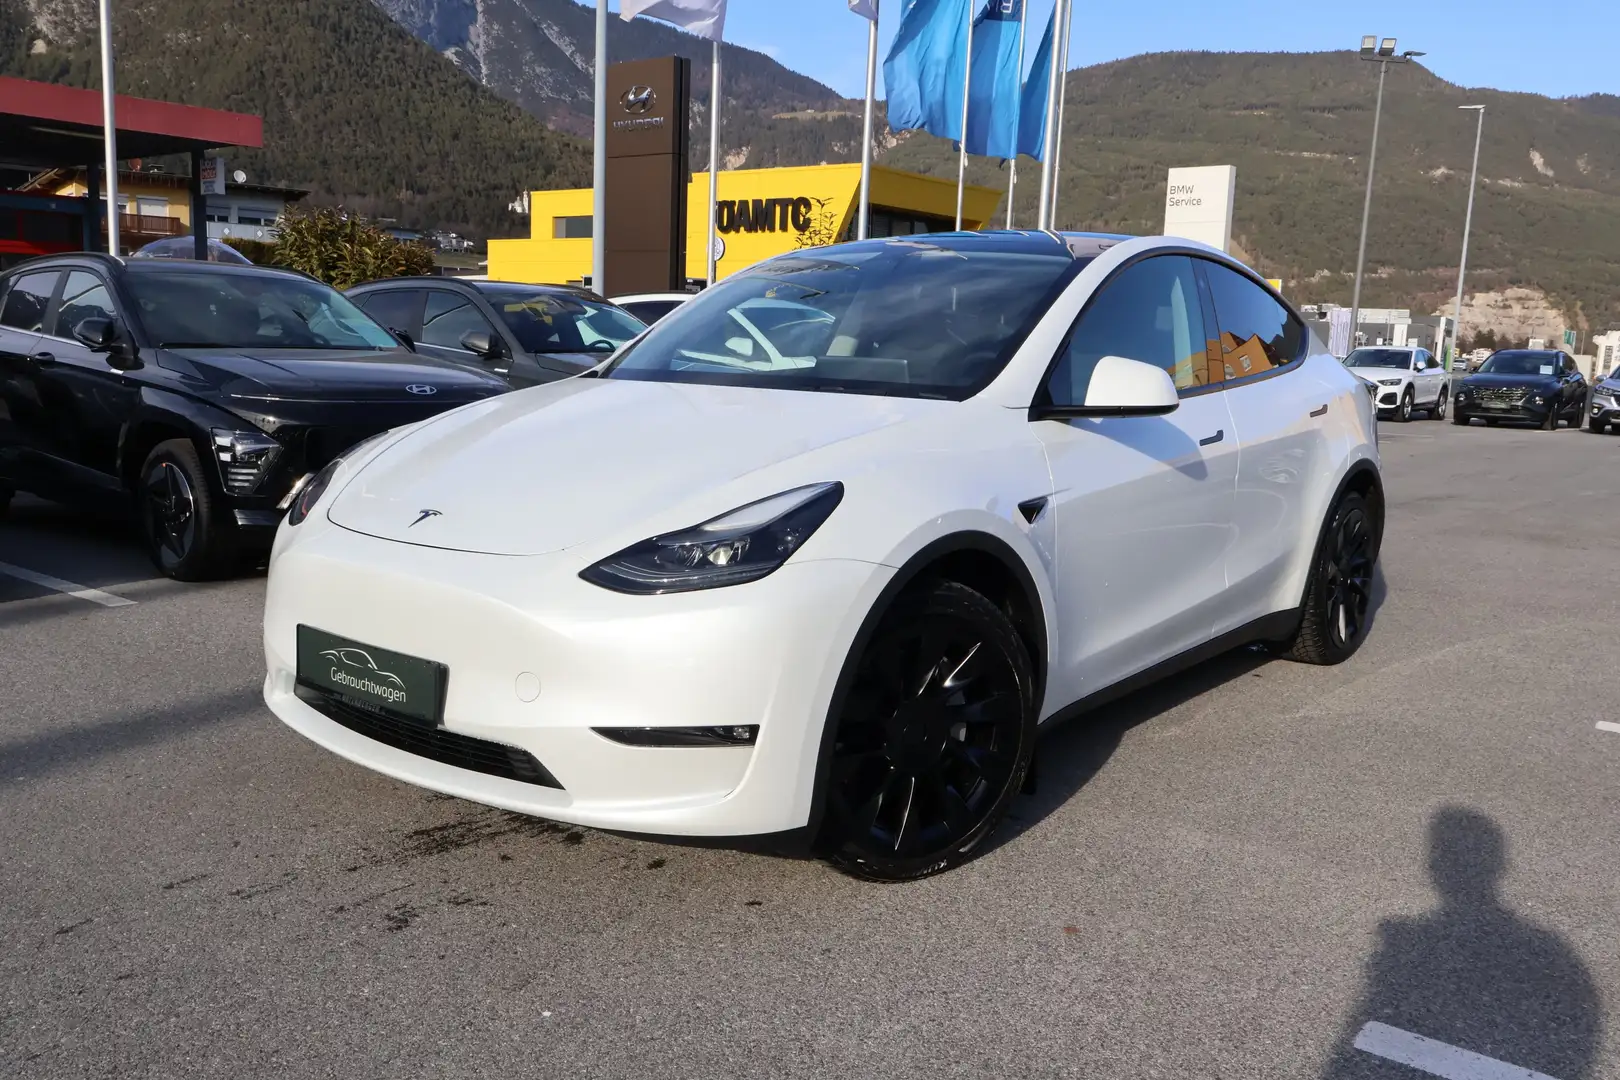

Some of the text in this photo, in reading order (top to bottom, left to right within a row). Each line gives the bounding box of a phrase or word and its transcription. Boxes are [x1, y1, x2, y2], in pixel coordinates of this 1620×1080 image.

[1170, 185, 1194, 195] BMW
[1169, 197, 1202, 207] Service
[330, 666, 407, 703] Gebrauchtwagen
